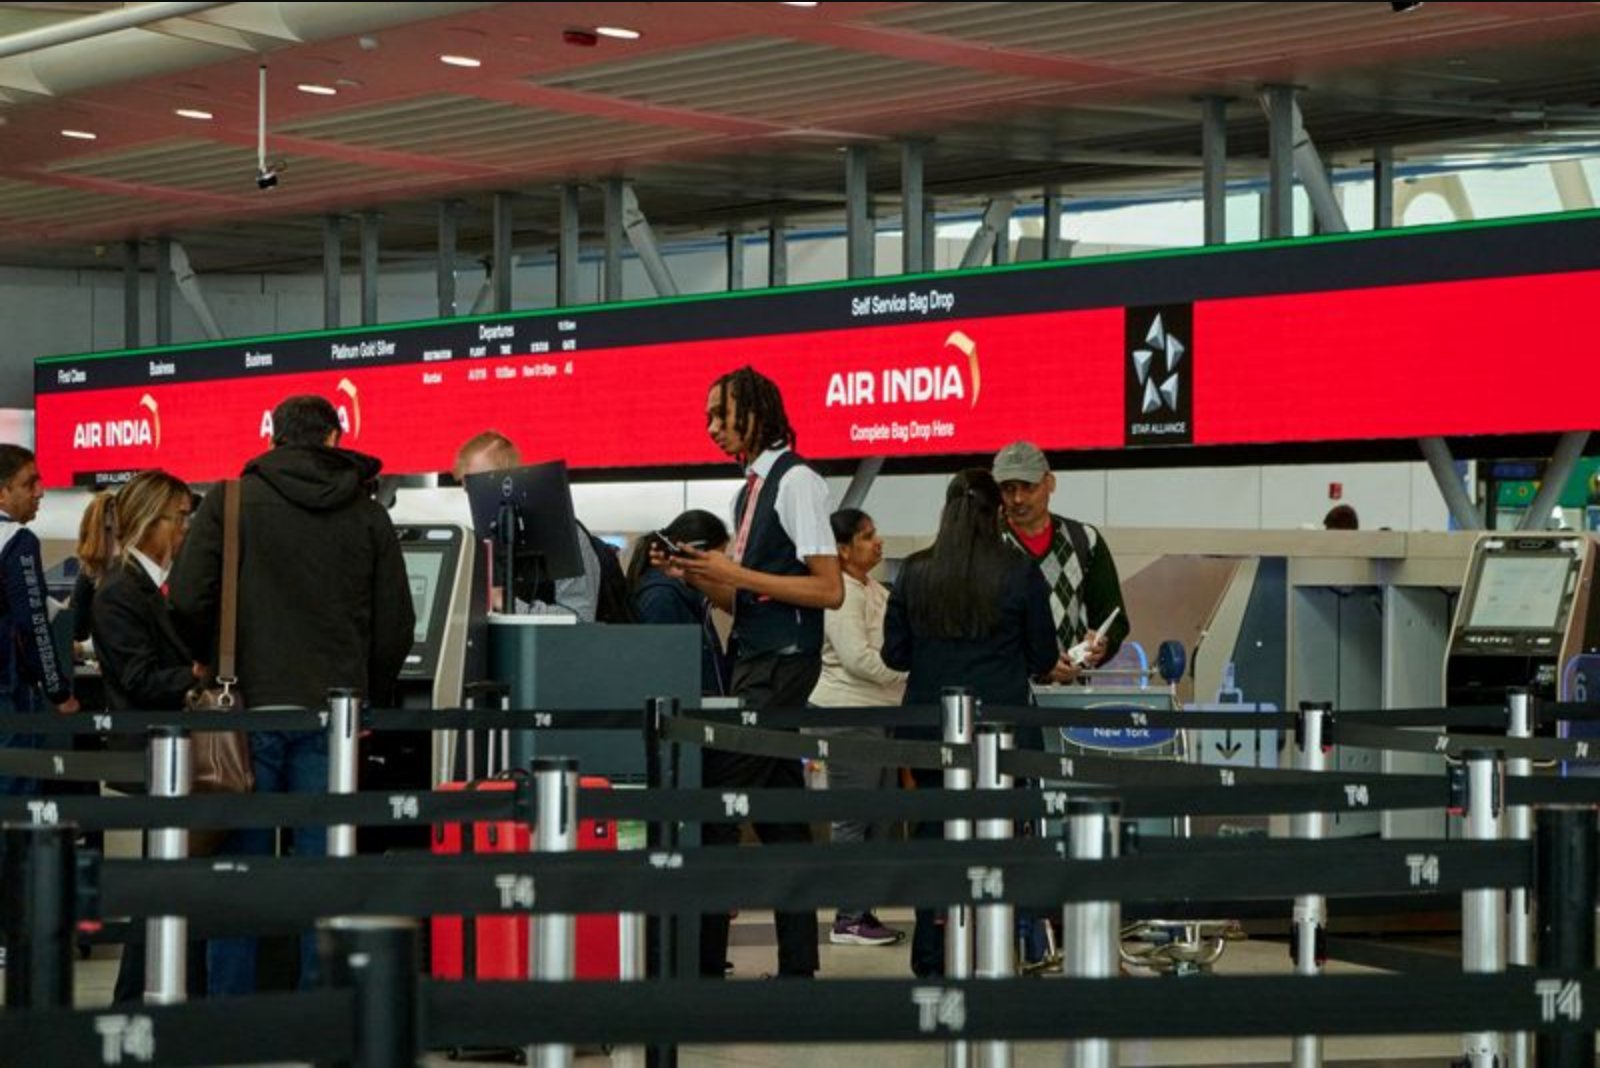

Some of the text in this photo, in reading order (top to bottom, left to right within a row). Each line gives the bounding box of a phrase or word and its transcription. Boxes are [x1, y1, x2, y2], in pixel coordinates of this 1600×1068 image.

[852, 290, 955, 316] Self Service Bag Drop
[479, 324, 515, 342] Departures
[245, 352, 273, 368] Business
[331, 340, 396, 360] Platinum Gold Silver
[149, 361, 175, 376] Business
[825, 365, 965, 407] AIR INDIA
[73, 419, 152, 449] AIR INDIA
[851, 420, 955, 443] Complete Bag Drop Here
[93, 714, 113, 731] T4
[319, 712, 328, 727] T
[534, 712, 552, 727] T4
[742, 710, 757, 725] T4
[1130, 712, 1148, 726] T4
[1093, 727, 1150, 738] New York
[722, 792, 750, 817] T4
[1042, 791, 1068, 814] T4
[1343, 784, 1369, 806] T4
[27, 801, 59, 824] T4
[389, 795, 419, 819] T4
[1405, 854, 1440, 886] T4
[495, 874, 535, 909] T4
[967, 866, 1004, 900] T4
[912, 986, 966, 1032] T4
[1535, 979, 1583, 1022] T4
[95, 1014, 155, 1064] T4
